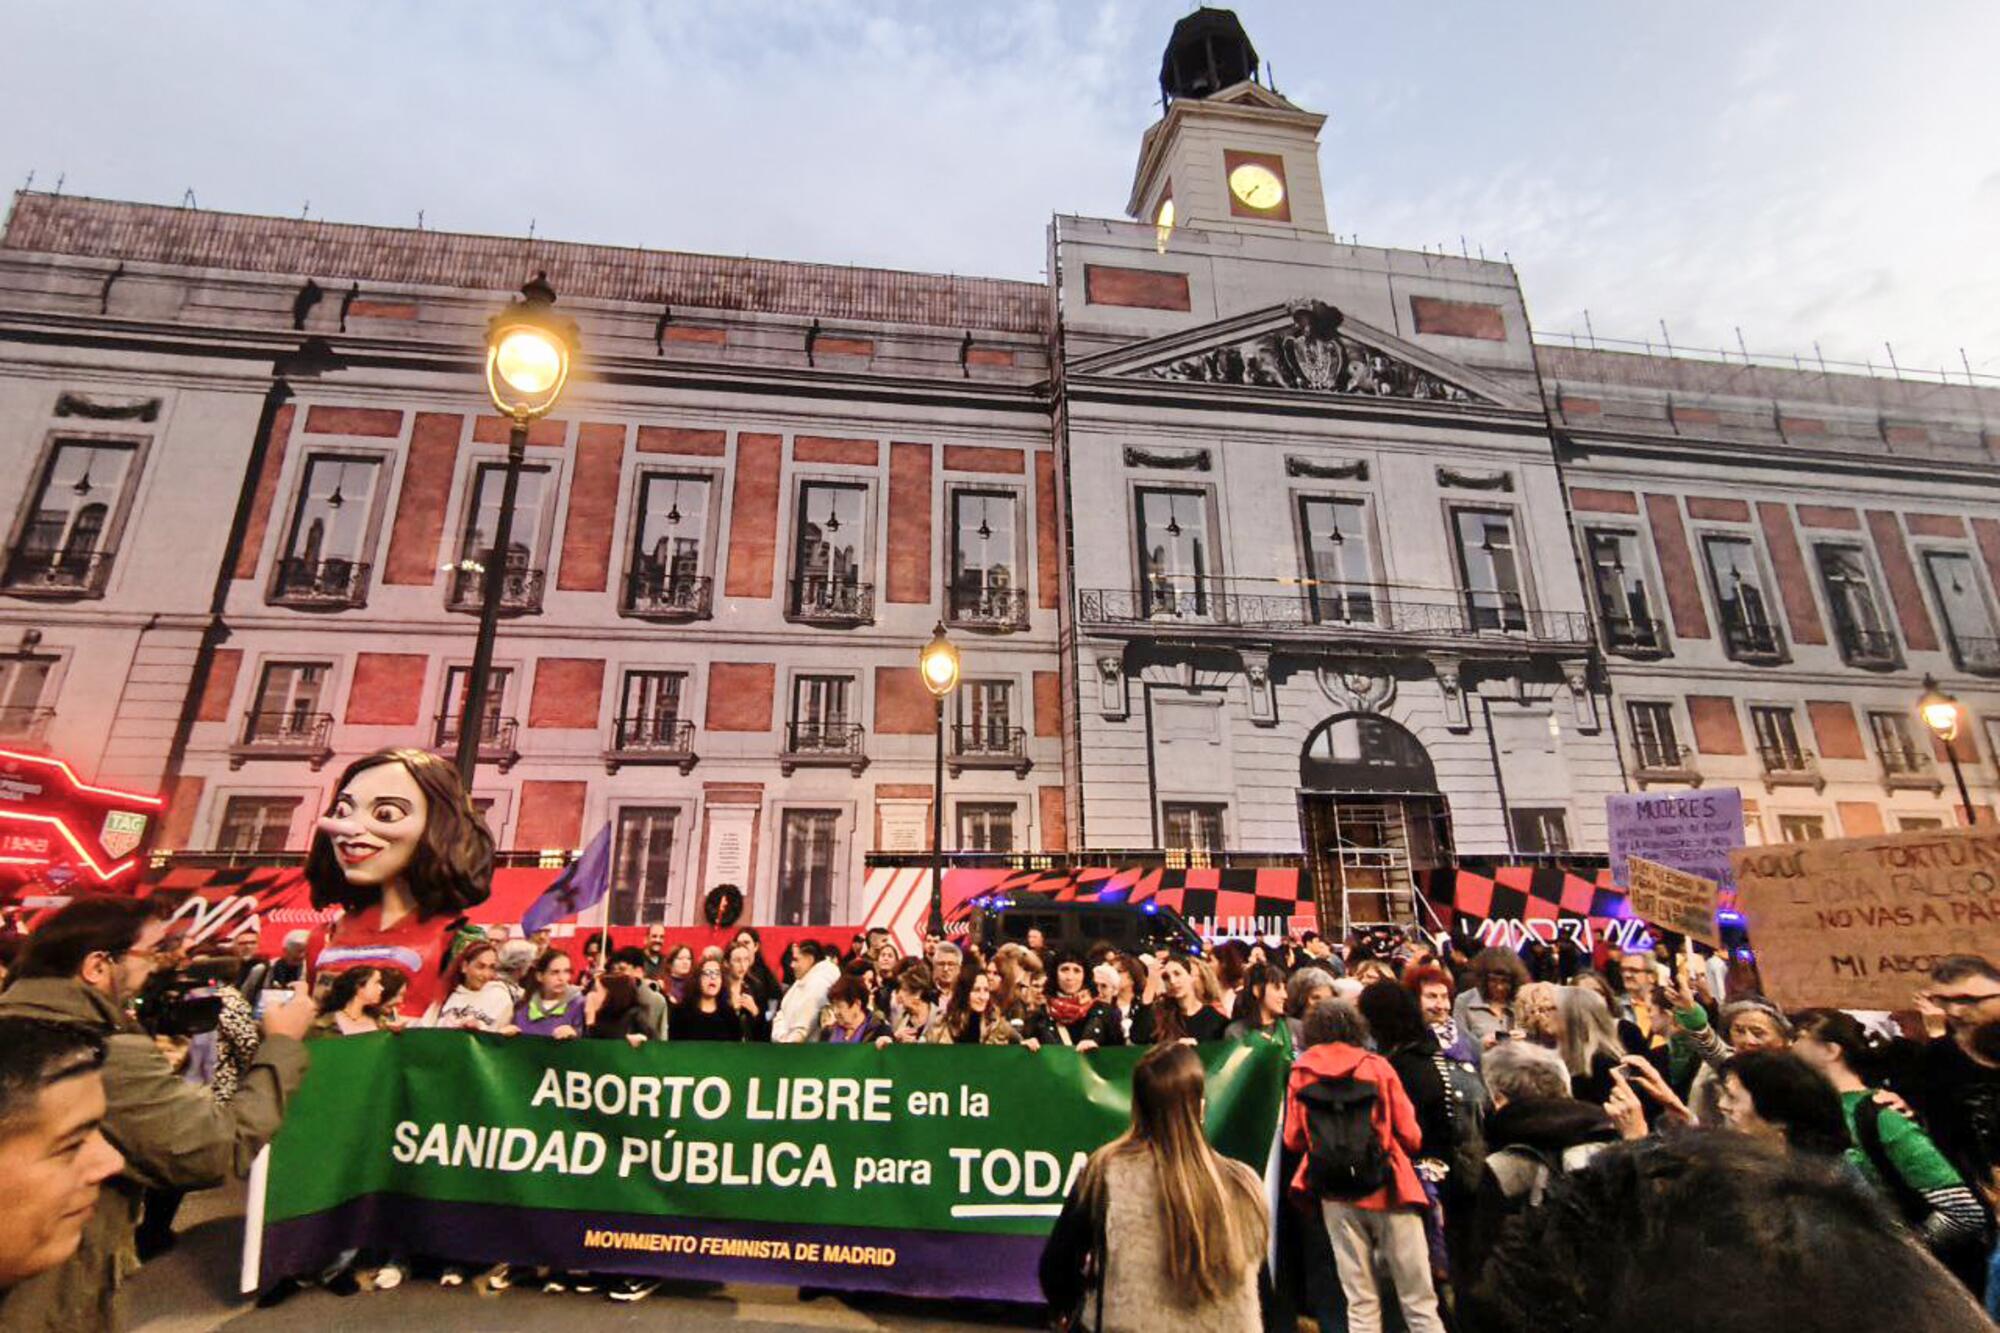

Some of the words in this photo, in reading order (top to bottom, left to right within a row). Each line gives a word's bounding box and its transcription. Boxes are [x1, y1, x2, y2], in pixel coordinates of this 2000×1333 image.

[1636, 796, 1717, 820] MUJERES
[111, 814, 146, 831] TAG
[1817, 908, 1853, 930] NO
[1856, 906, 1914, 928] VAS
[1921, 903, 1944, 924] A
[1831, 955, 1868, 977] MI
[530, 1068, 732, 1120] ABORTO
[746, 1077, 893, 1121] LIBRE
[907, 1091, 949, 1117] en
[960, 1084, 990, 1118] la
[392, 1121, 607, 1176] SANIDAD
[617, 1129, 837, 1188] PÚBLICA
[854, 1156, 932, 1190] para
[583, 1229, 698, 1254] MOVIMIENTO
[699, 1236, 791, 1260] FEMINISTA
[794, 1242, 821, 1262] DE
[822, 1244, 896, 1267] MADRID
